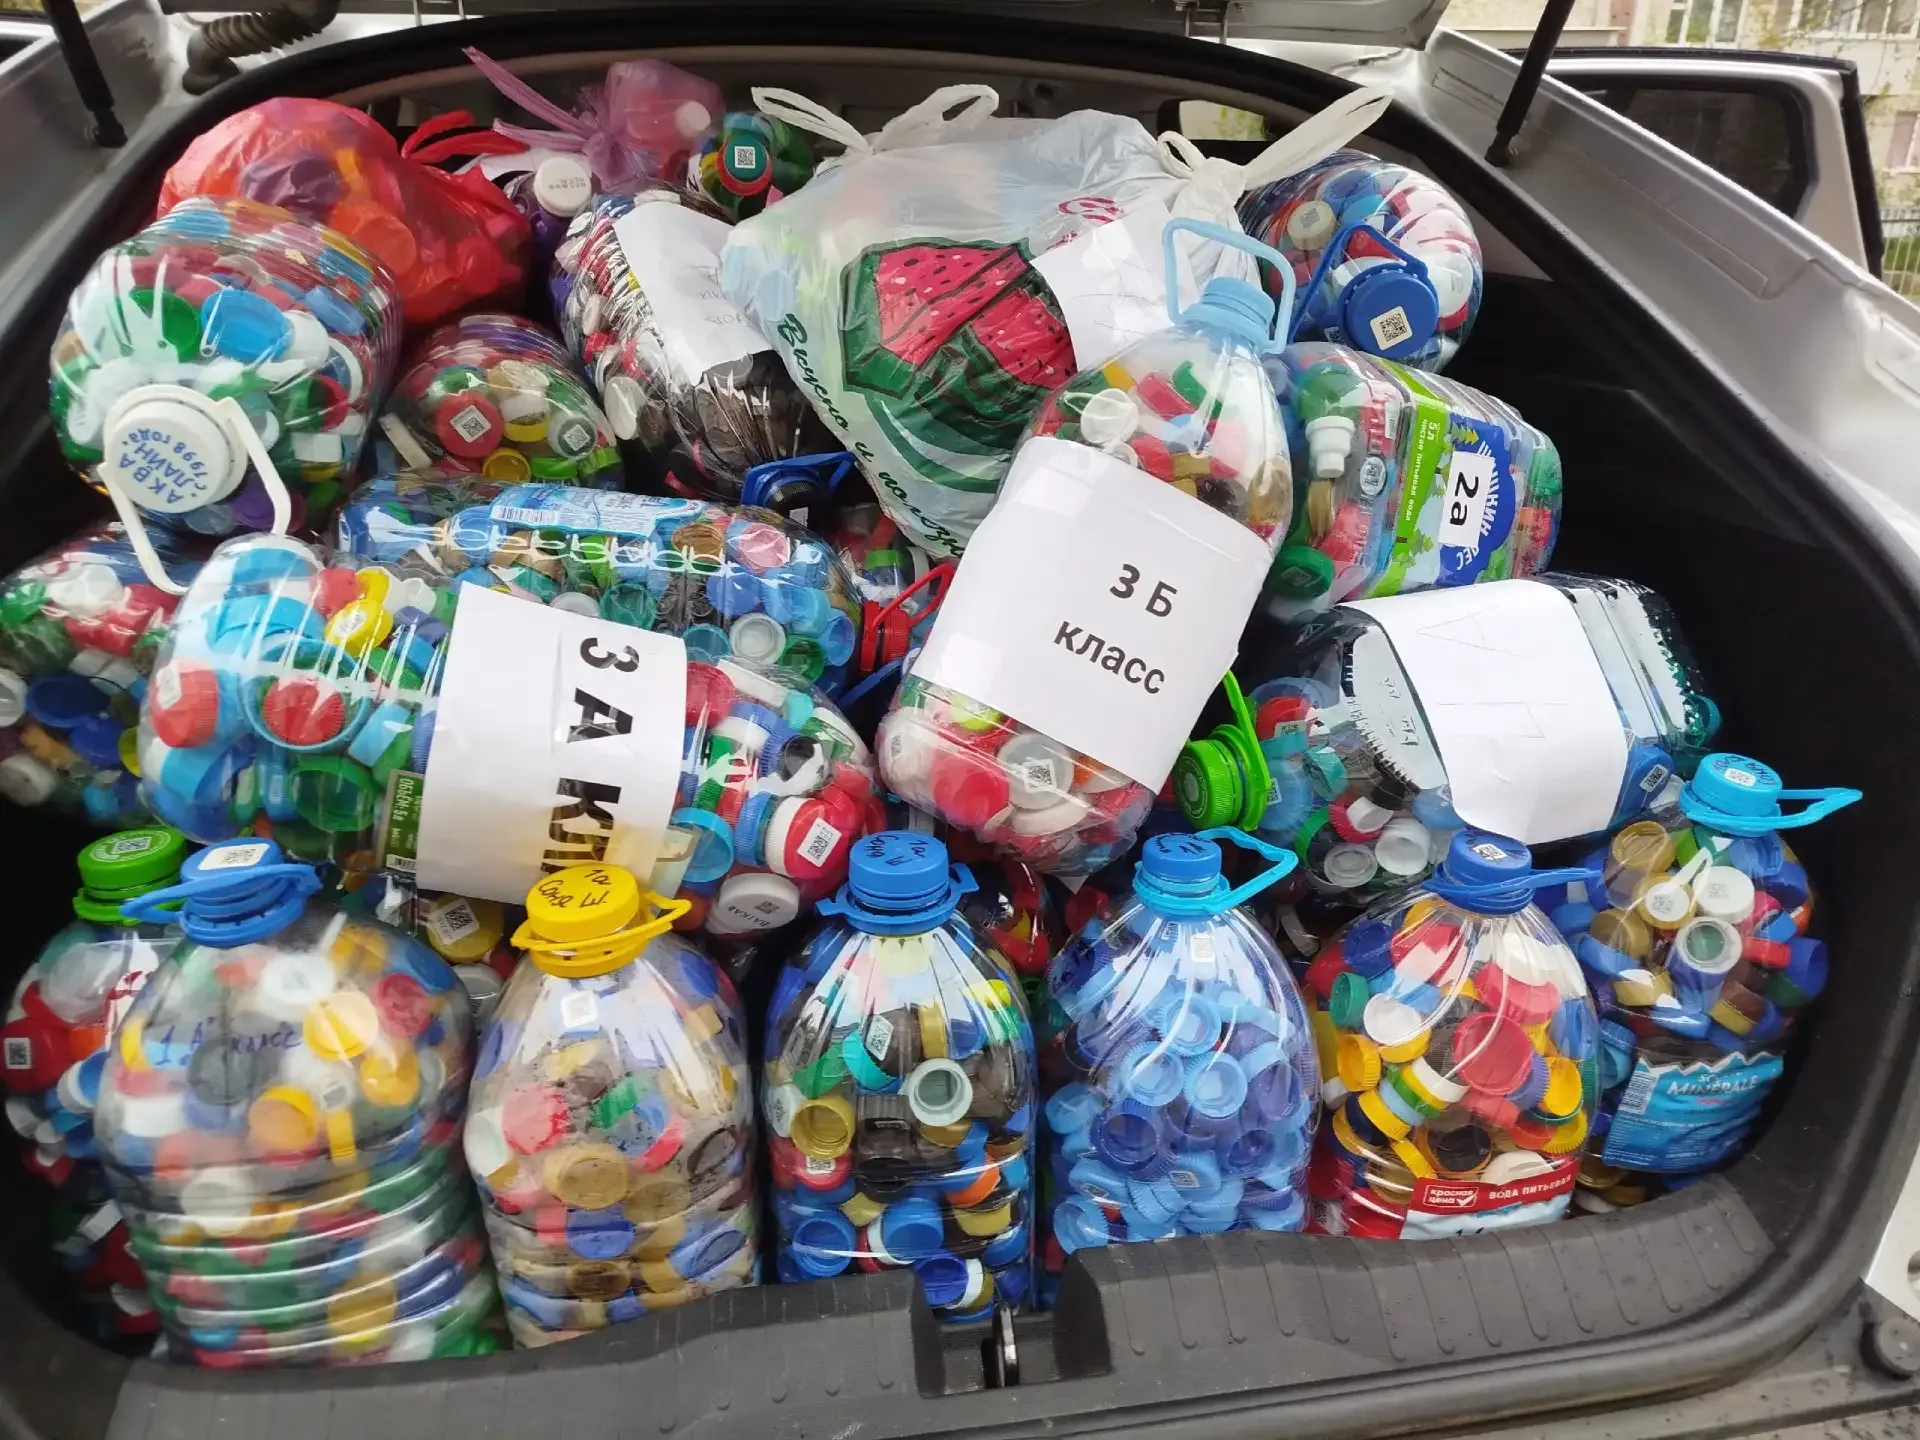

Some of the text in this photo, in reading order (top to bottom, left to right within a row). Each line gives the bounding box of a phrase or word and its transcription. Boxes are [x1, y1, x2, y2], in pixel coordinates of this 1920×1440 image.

[119, 452, 184, 503] АКВА
[134, 442, 195, 488] ЛАЙН
[173, 442, 208, 478] 1998
[1450, 472, 1479, 526] 2а
[1053, 620, 1165, 694] класс
[540, 777, 622, 874] КЛ
[1488, 1174, 1571, 1200] ВОДА ПИТЬЕВАЯ
